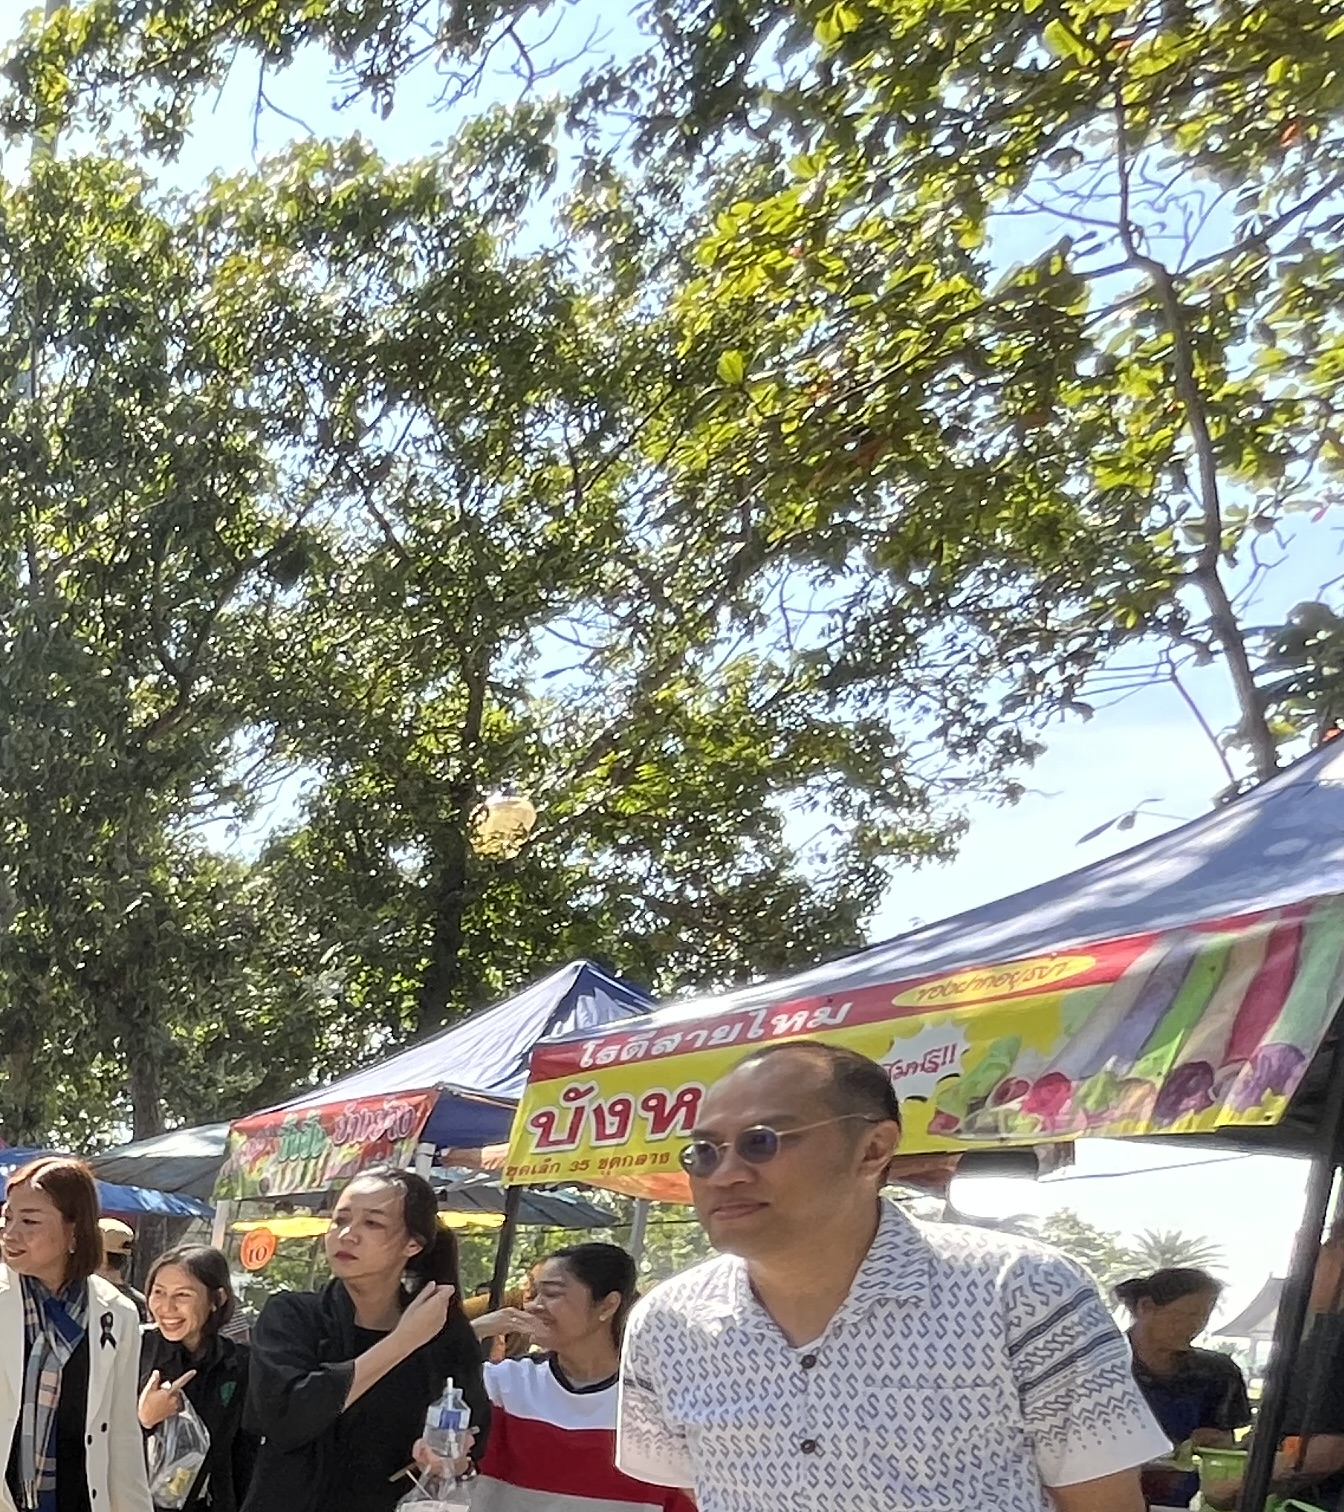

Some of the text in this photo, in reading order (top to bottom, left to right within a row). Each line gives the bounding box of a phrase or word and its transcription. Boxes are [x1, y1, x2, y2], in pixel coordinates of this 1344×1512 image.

[578, 1001, 852, 1069] โรตีสายไหม
[528, 1084, 703, 1148] บังห
[569, 1159, 591, 1172] 35
